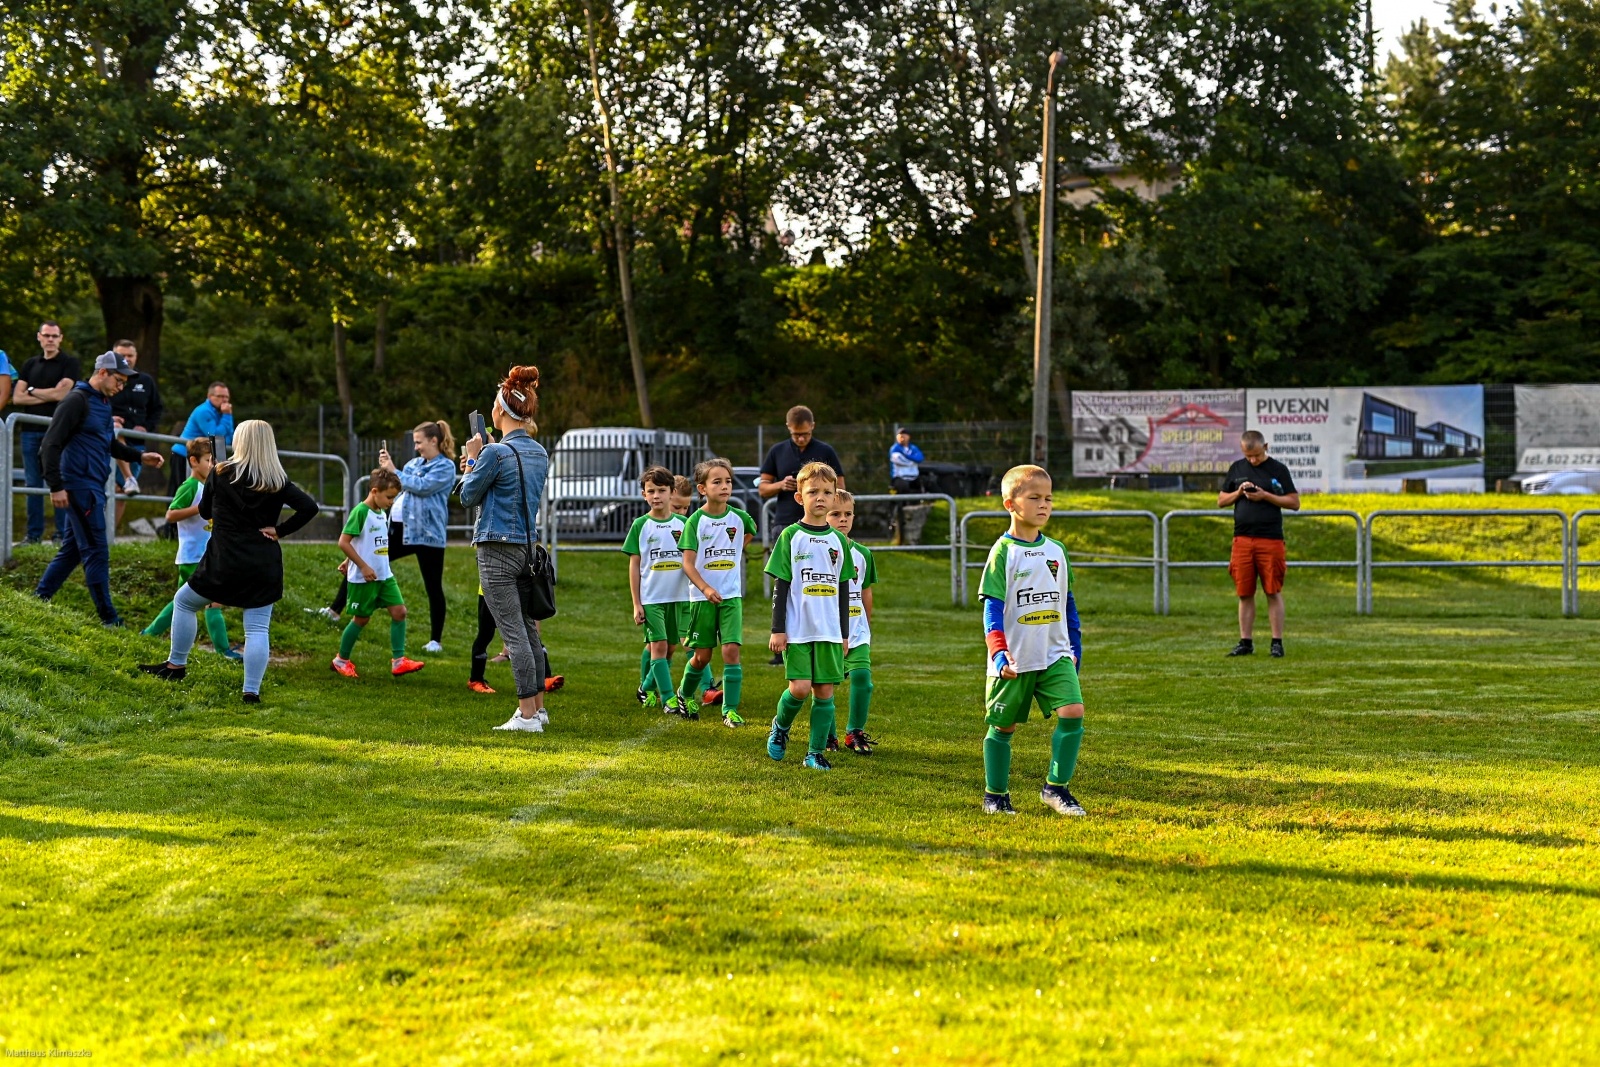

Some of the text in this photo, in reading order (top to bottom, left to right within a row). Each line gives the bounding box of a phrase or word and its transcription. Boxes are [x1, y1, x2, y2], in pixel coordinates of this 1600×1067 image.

[1257, 398, 1329, 414] PIVEXIN
[1257, 414, 1329, 424] TECHNOLOGY
[1273, 433, 1312, 442] DOSTAWCA
[1547, 453, 1569, 464] 602
[1572, 453, 1593, 464] 252
